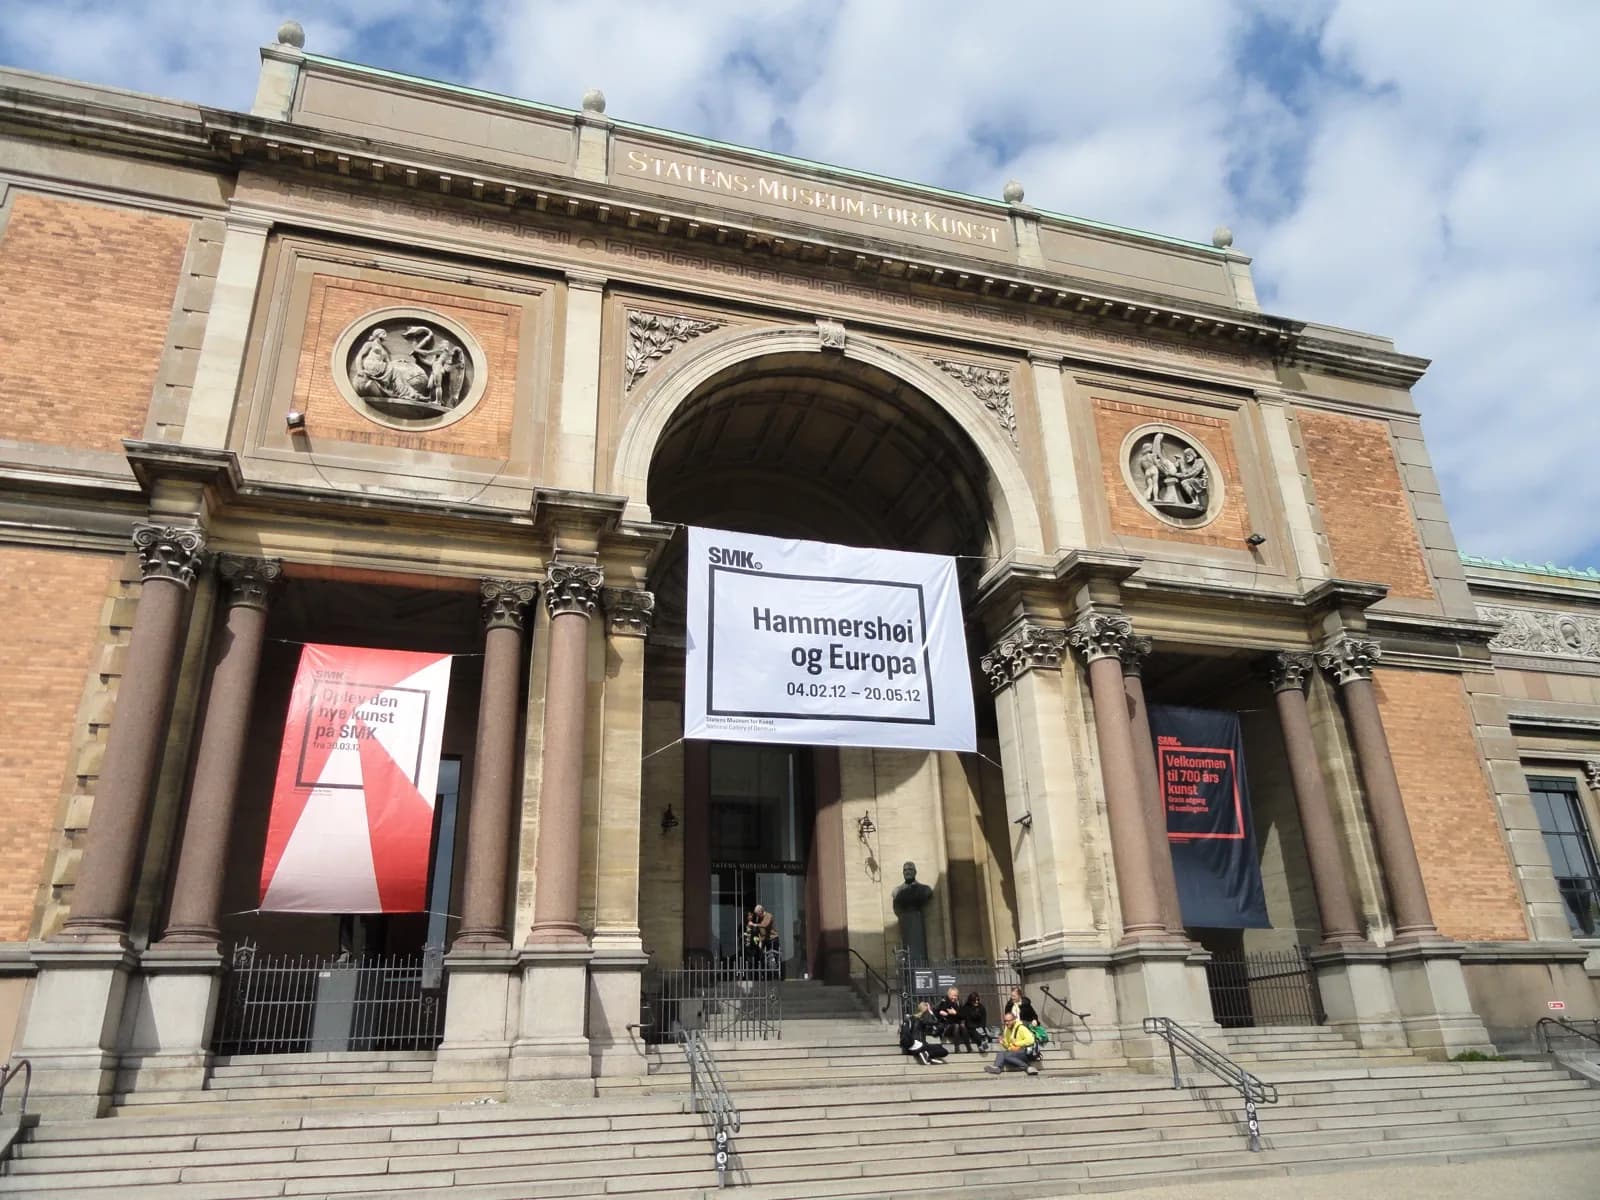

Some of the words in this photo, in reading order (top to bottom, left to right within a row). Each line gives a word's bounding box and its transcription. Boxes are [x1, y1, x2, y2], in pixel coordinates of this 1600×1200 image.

[628, 150, 747, 193] STATENS
[759, 177, 864, 214] MUSEUM
[873, 205, 917, 227] FOR
[925, 212, 999, 244] KUNST
[708, 546, 755, 570] SMK
[753, 606, 913, 643] Hammershøi
[791, 645, 822, 675] og
[829, 643, 917, 680] Europa
[370, 694, 398, 708] den
[787, 682, 846, 698] 04.02.12
[864, 687, 920, 702] 20.05.12
[320, 706, 350, 722] nye
[352, 708, 394, 724] kunst
[315, 723, 335, 741] på
[339, 724, 377, 741] SMK
[1166, 754, 1226, 769] Velkommen
[1167, 770, 1178, 781] til
[1180, 770, 1200, 782] 700
[1202, 771, 1219, 783] års
[1168, 783, 1198, 795] kunst
